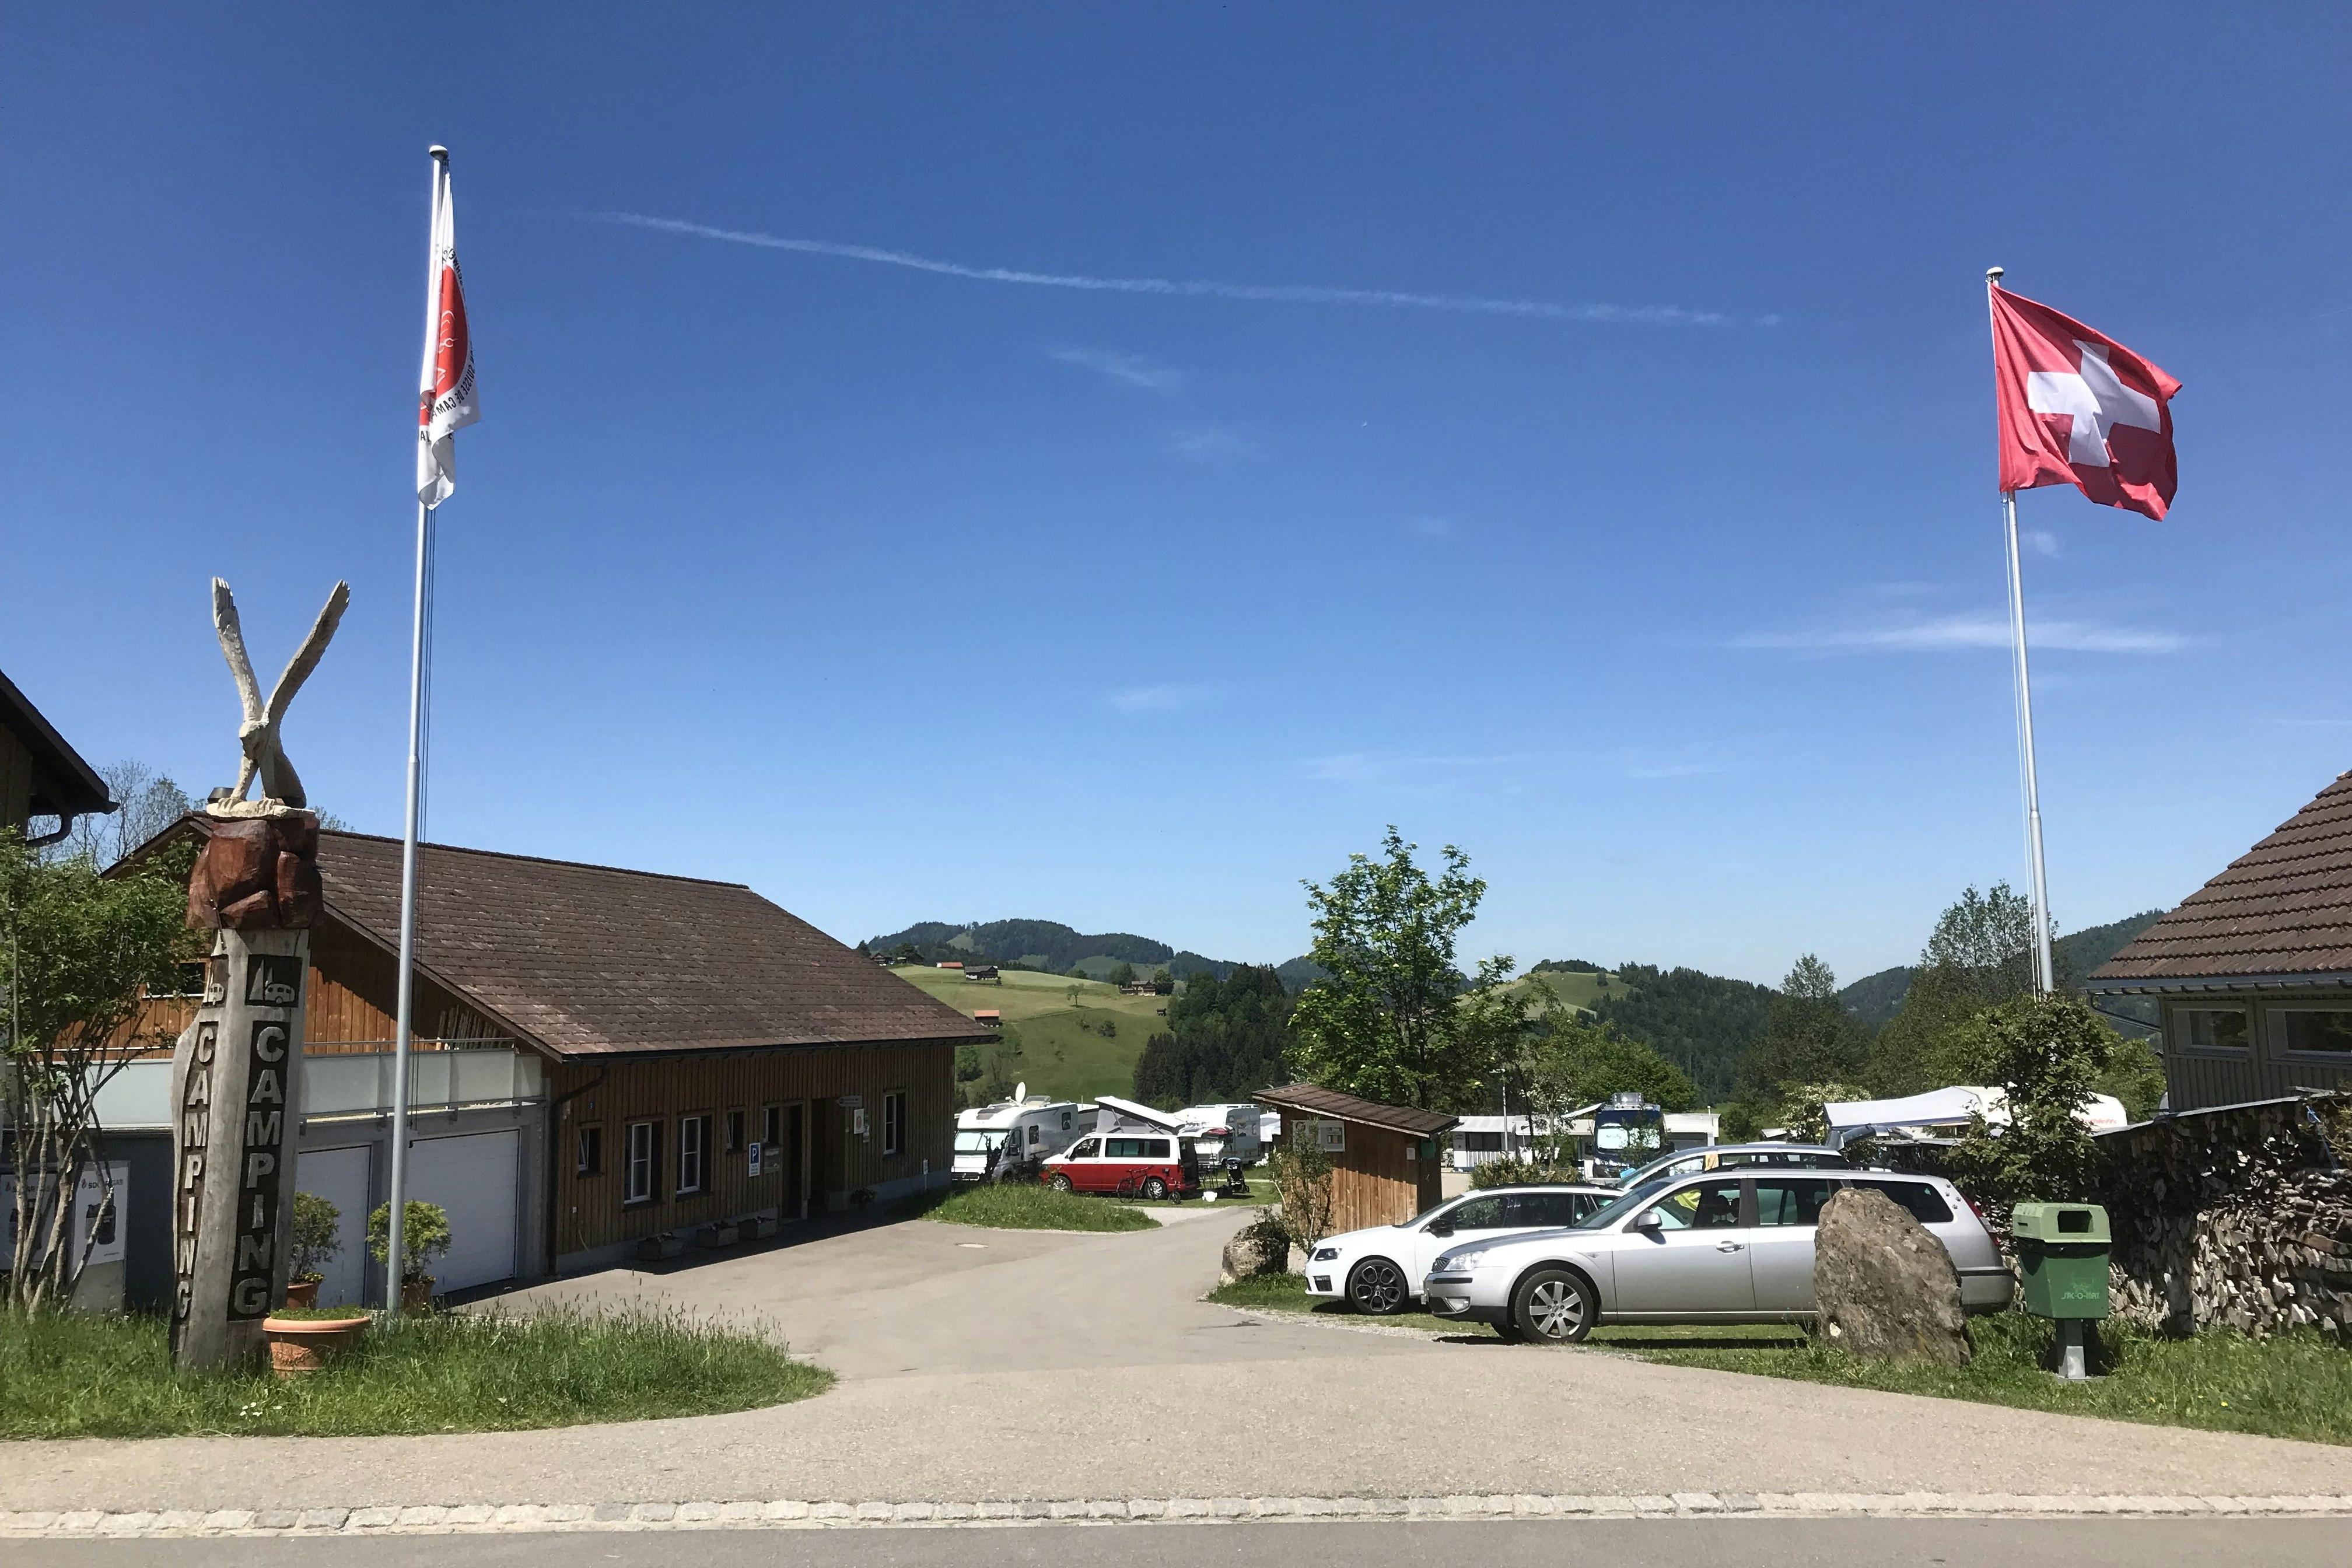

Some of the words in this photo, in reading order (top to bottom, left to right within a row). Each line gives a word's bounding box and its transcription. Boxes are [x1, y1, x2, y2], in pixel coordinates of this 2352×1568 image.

[176, 1026, 214, 1319] CAMPING
[234, 1026, 286, 1315] CAMPING
[752, 1147, 758, 1162] P
